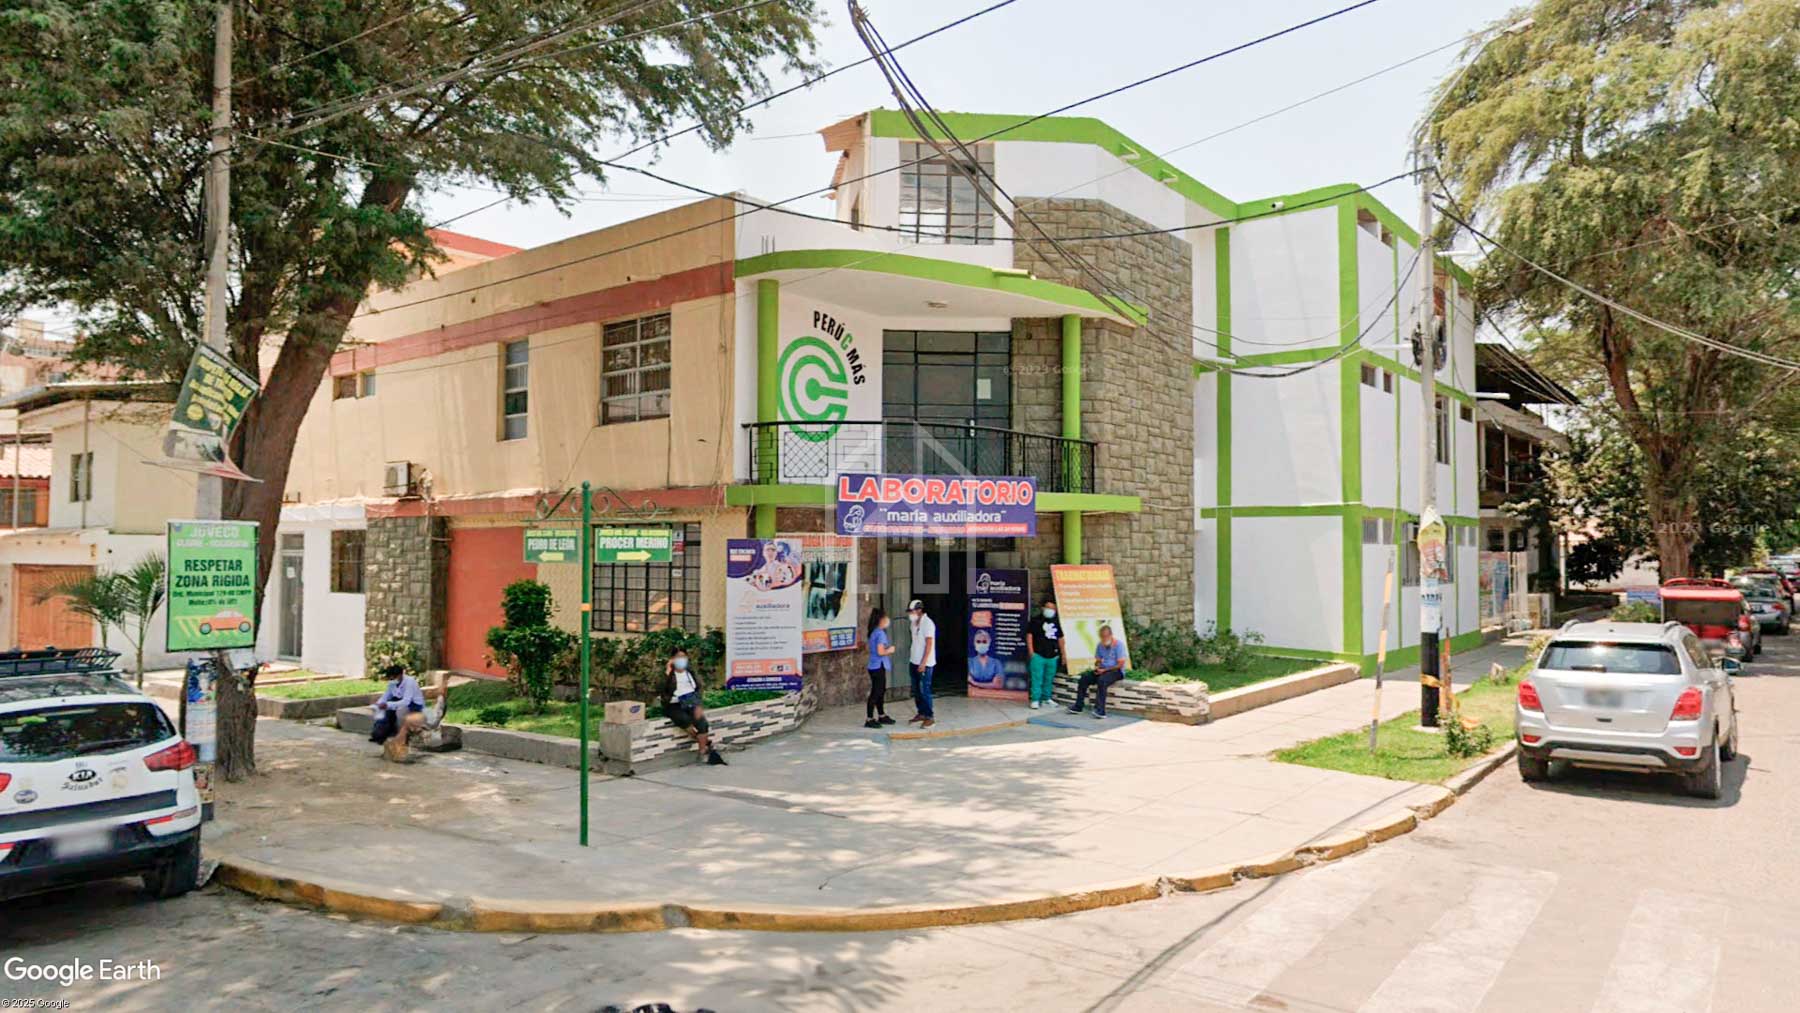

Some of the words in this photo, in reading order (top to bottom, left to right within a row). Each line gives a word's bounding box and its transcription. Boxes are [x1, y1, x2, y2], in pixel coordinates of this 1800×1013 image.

[838, 476, 1034, 505] LABORATORIO
[184, 559, 243, 571] RESPETAR
[175, 575, 208, 588] ZONA
[212, 574, 250, 587] RIGIDA
